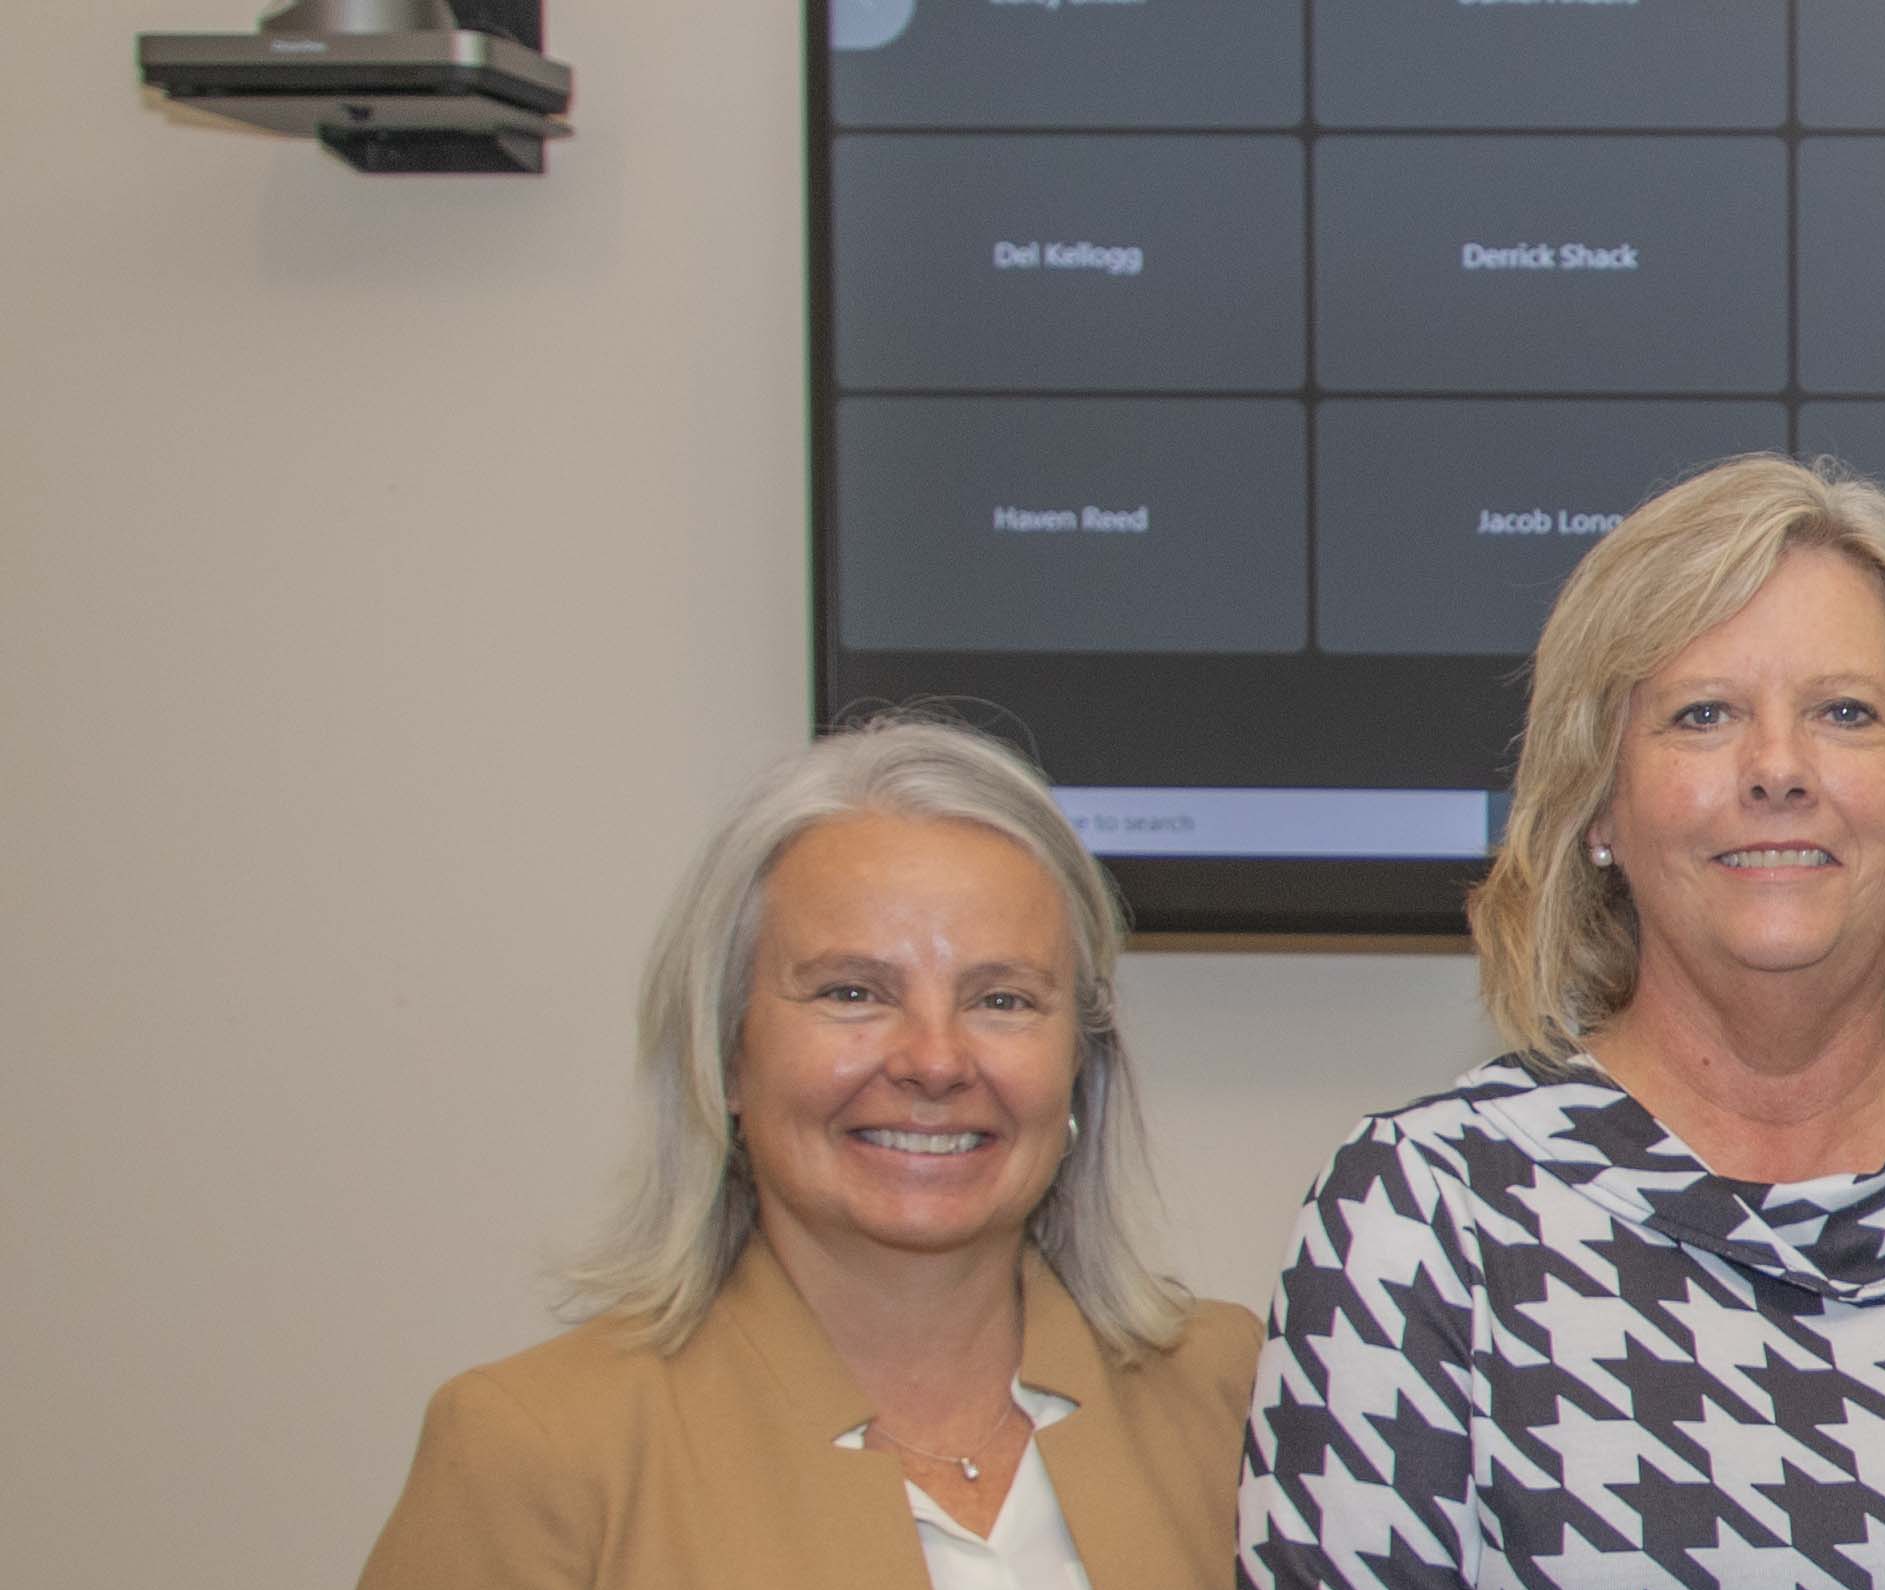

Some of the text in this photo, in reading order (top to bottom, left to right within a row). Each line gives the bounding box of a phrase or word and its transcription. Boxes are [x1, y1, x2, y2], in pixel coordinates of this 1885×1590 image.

[994, 241, 1143, 275] Del Kellogg
[1463, 243, 1639, 269] Derrick Shack
[993, 505, 1148, 532] Haven Reed
[1477, 508, 1553, 535] Jacob
